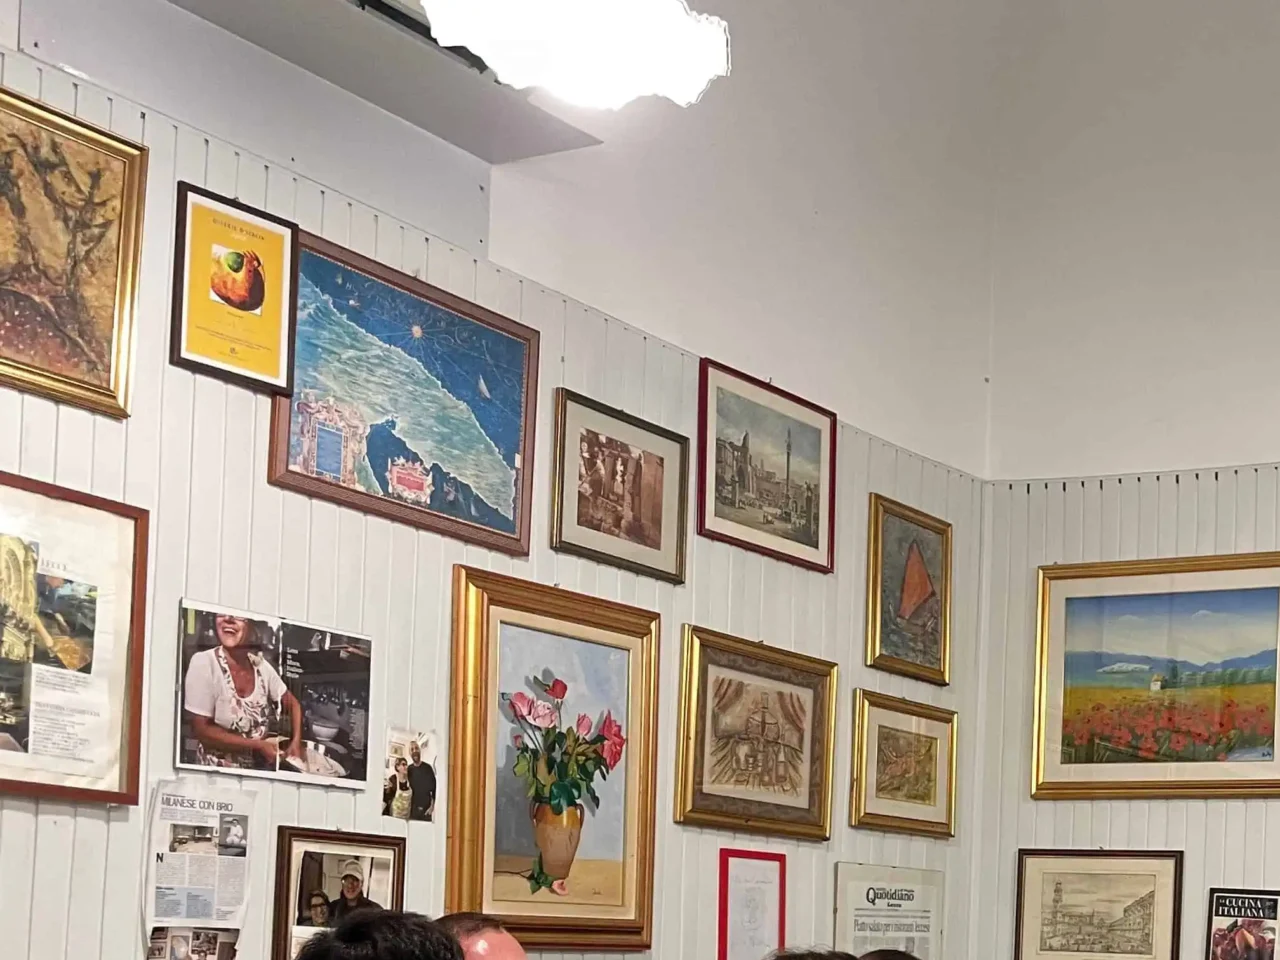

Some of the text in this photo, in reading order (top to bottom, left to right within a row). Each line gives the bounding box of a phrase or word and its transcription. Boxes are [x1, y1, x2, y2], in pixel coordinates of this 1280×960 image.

[161, 796, 233, 812] MILANESE CON BRIO
[156, 852, 164, 863] N
[866, 887, 915, 906] Quotidiano
[1226, 898, 1261, 908] CUCINA
[1219, 906, 1264, 917] ITALIANA
